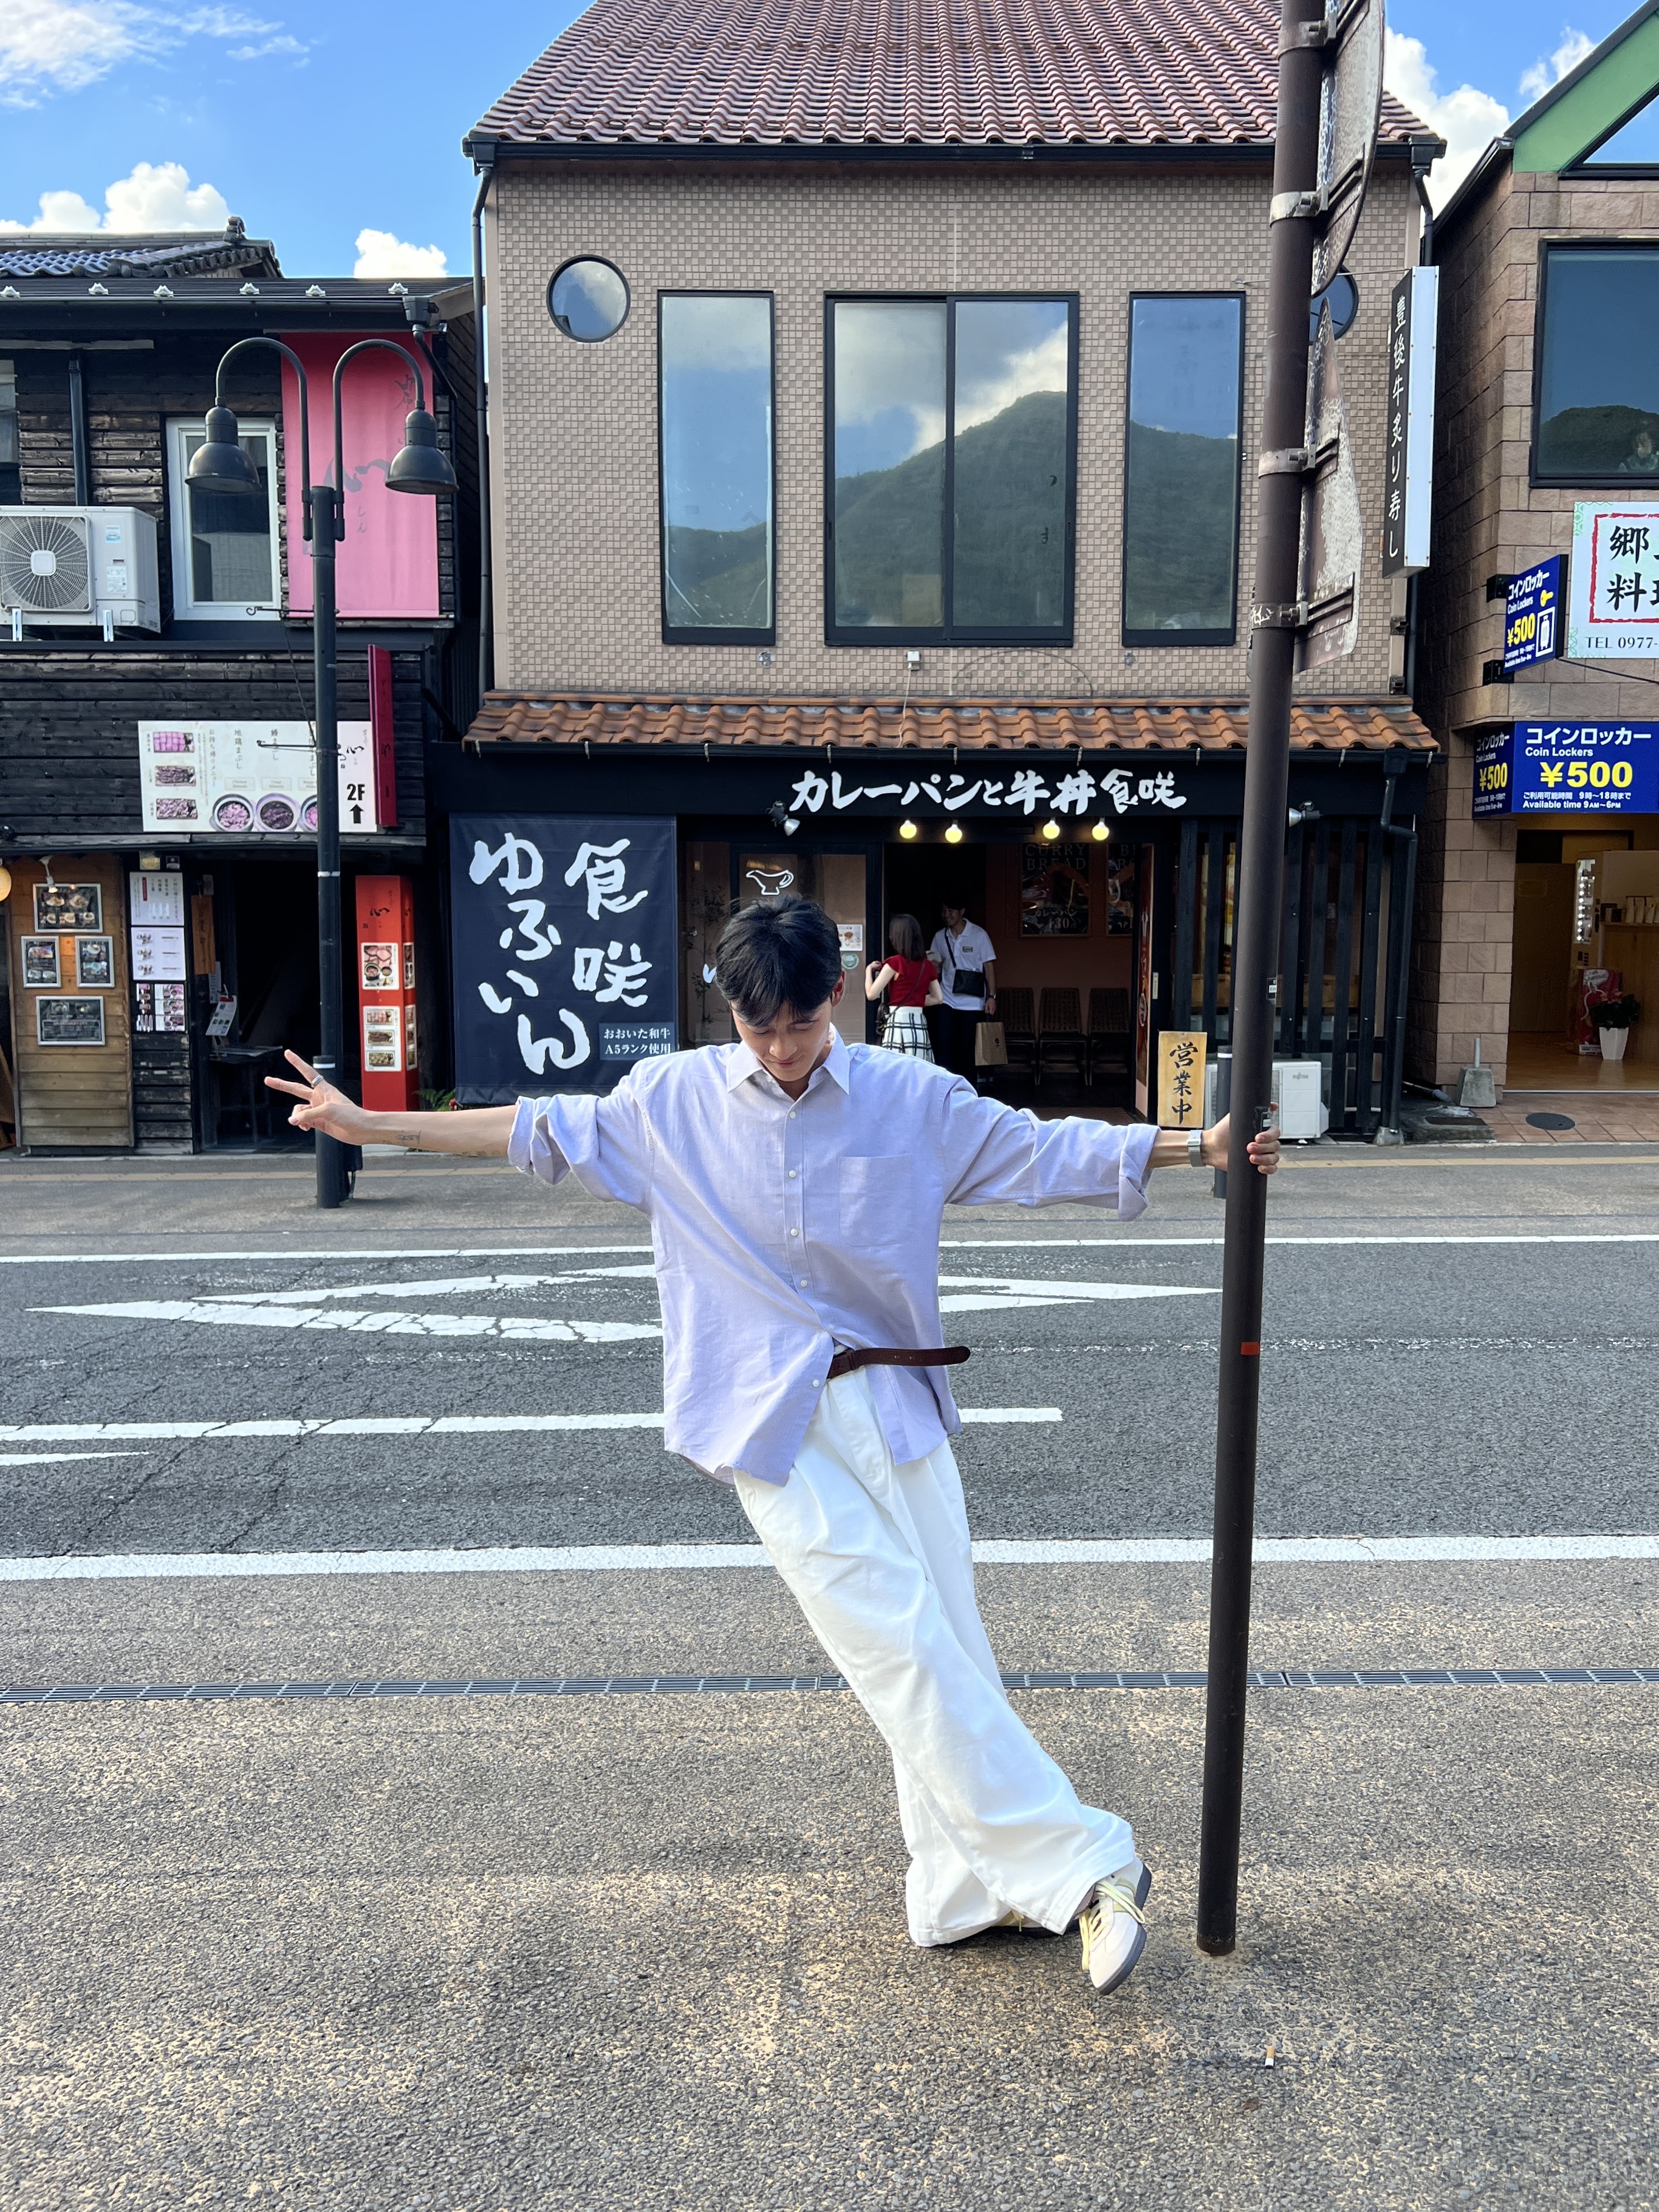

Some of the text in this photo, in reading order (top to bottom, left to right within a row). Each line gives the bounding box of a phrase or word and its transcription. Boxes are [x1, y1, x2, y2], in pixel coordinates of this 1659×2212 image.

[1387, 295, 1407, 558] 豊後牛炙り寿し
[1610, 526, 1659, 564] 郷
[1508, 569, 1550, 601] コインロッカー
[1507, 596, 1534, 615] Coin Lockers
[1507, 612, 1536, 647] ¥500
[1584, 636, 1659, 649] TEL 0977-
[1476, 731, 1510, 752] コインロッカー
[1526, 727, 1652, 746] コインロッカー
[1525, 747, 1593, 757] Coin Lockers
[1479, 762, 1508, 792] ¥500
[1539, 761, 1633, 788] ¥500
[346, 783, 366, 801] 2F
[1522, 800, 1562, 809] Available
[1025, 843, 1087, 857] CURRY
[469, 832, 590, 1075] ゆふいん
[603, 1027, 671, 1040] おおいた和牛
[604, 1043, 671, 1055] A5ランク使用
[1169, 1041, 1199, 1125] 営業中
